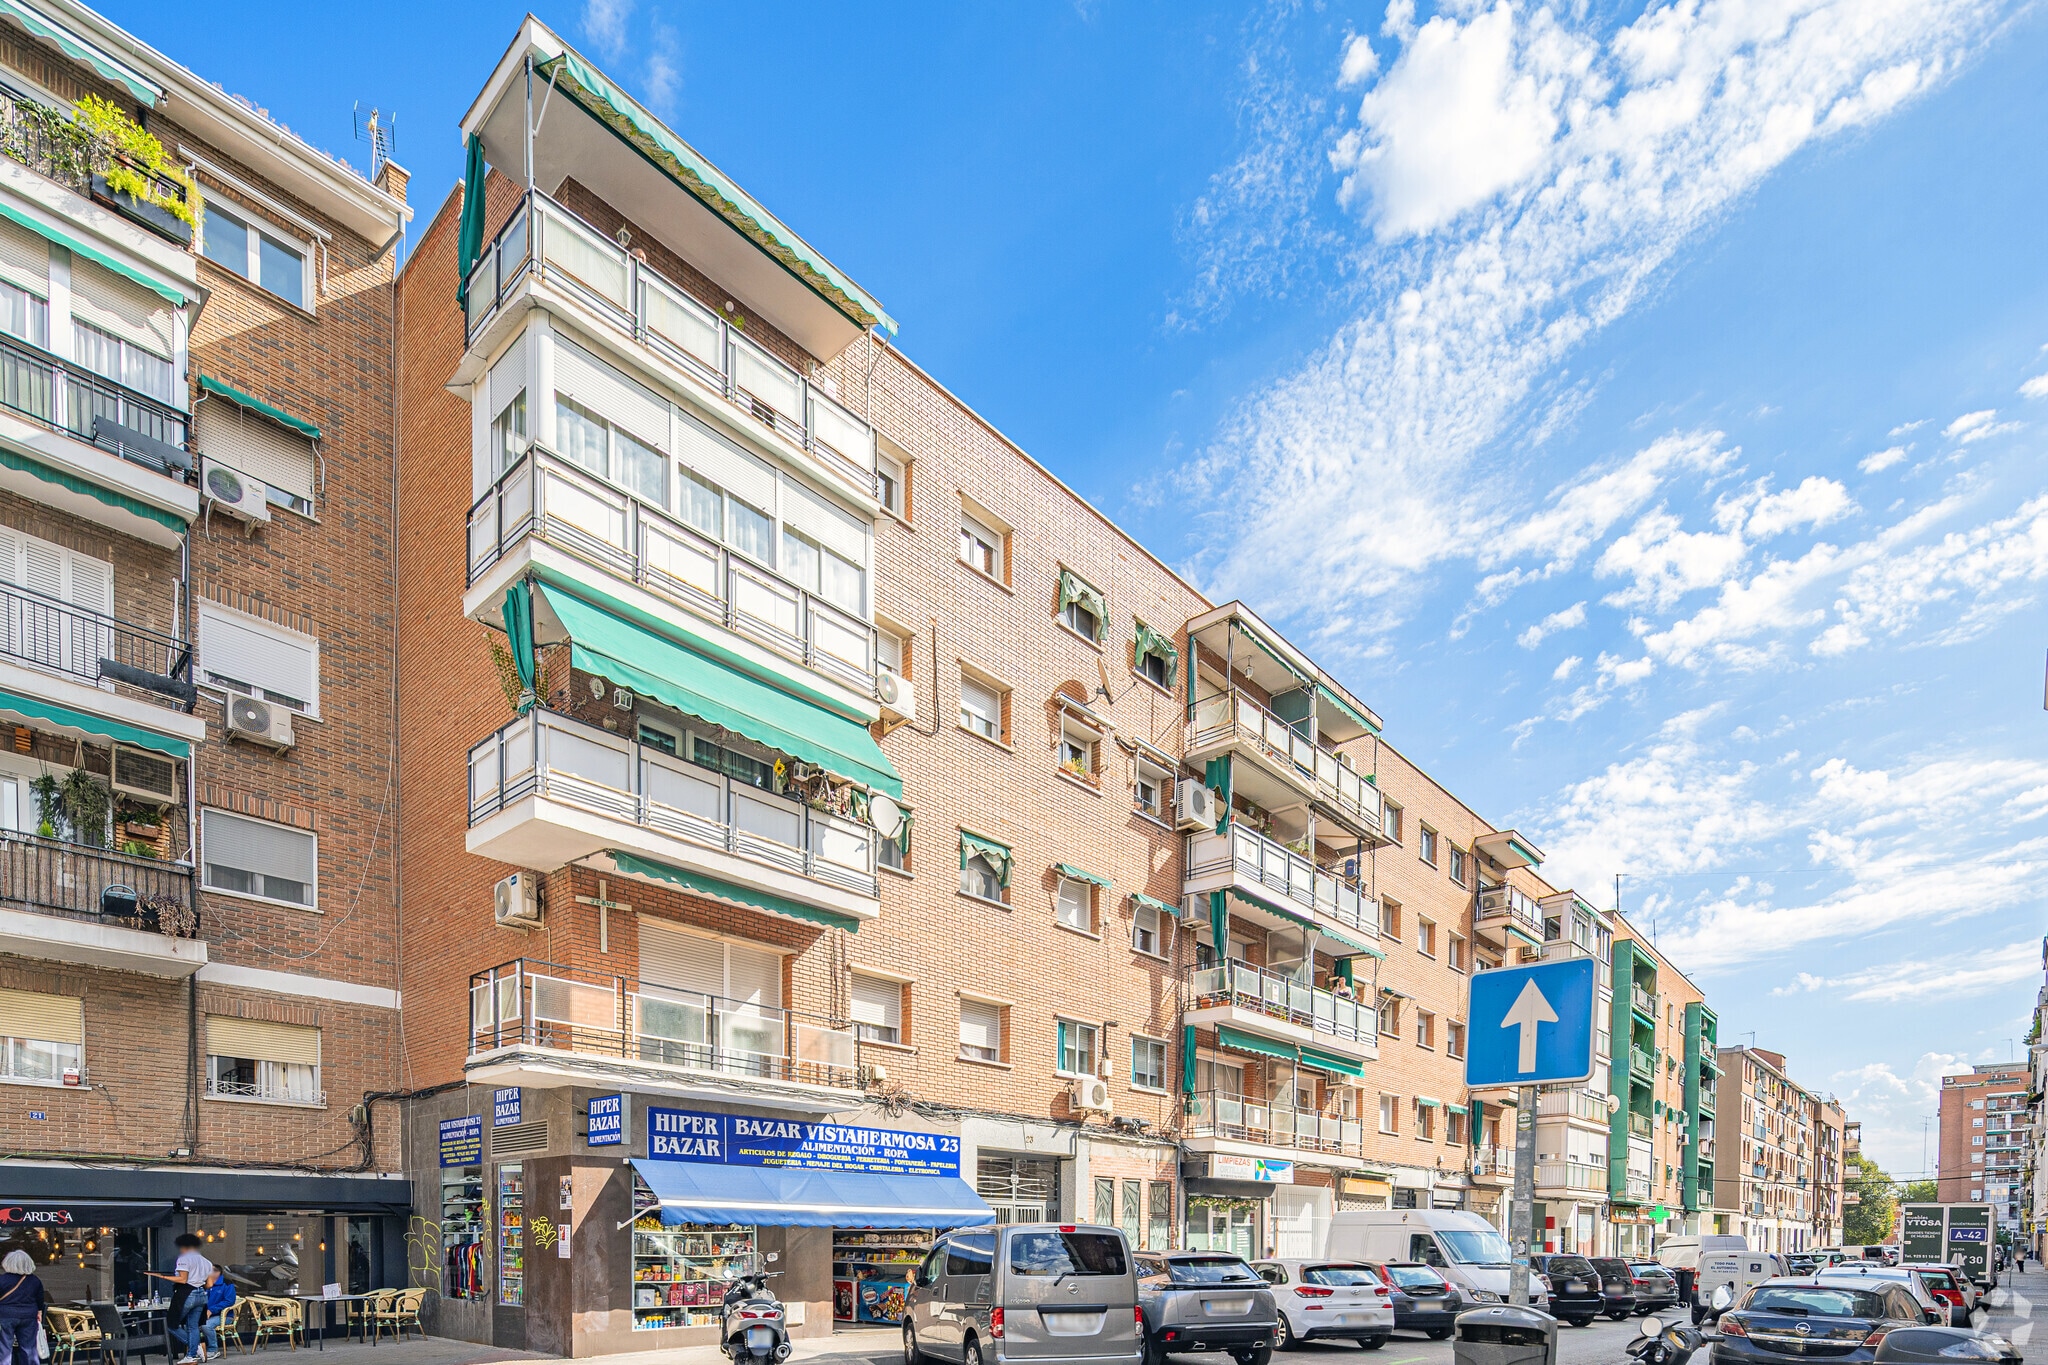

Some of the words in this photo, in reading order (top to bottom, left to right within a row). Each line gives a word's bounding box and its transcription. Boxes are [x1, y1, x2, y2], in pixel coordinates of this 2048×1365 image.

[590, 899, 617, 908] JESUS
[496, 1087, 519, 1103] HIPER
[495, 1101, 520, 1117] BAZAR
[590, 1098, 620, 1115] HIPER
[590, 1115, 620, 1132] BAZAR
[655, 1113, 718, 1135] HIPER
[589, 1131, 621, 1143] ALIMENTACIÓN
[735, 1118, 802, 1139] BAZAR
[806, 1124, 937, 1151] VISTAHERMOSA
[940, 1137, 959, 1153] 23
[653, 1136, 721, 1157] BAZAR
[739, 1148, 776, 1157] ARTICULOS
[777, 1149, 786, 1157] DE
[787, 1150, 812, 1159] REGALO
[802, 1141, 876, 1156] ALIMENTACIÓN
[883, 1148, 909, 1159] ROPA
[762, 1158, 802, 1166] JUGUETERIA
[1218, 1156, 1251, 1167] LIMPIEZAS
[1955, 1231, 1982, 1239] A-42
[1969, 1256, 1983, 1264] 30
